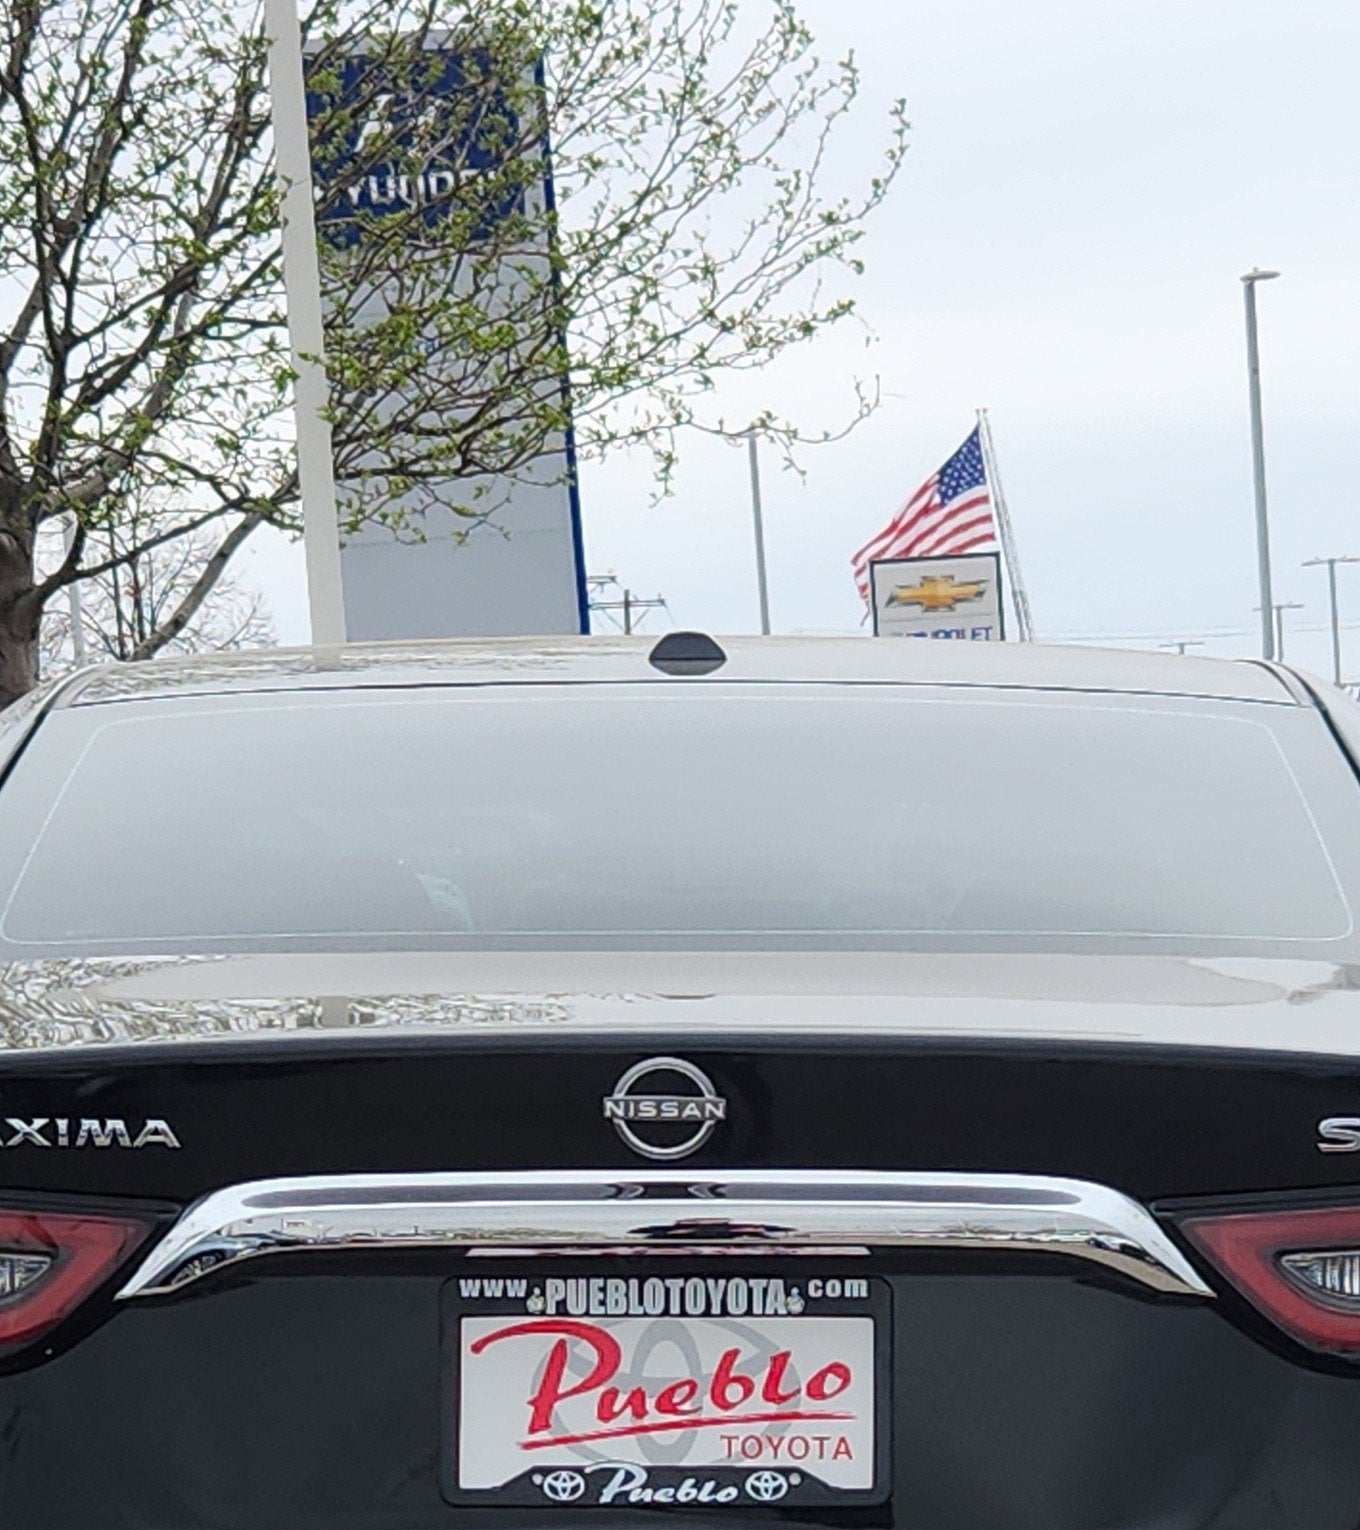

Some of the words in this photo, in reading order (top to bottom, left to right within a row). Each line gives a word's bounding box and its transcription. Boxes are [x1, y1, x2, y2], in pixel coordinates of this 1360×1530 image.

[604, 1100, 726, 1119] NISSAN
[471, 1319, 852, 1434] Pueblo
[720, 1434, 854, 1461] TOYOTA
[583, 1461, 739, 1504] Pueblo
